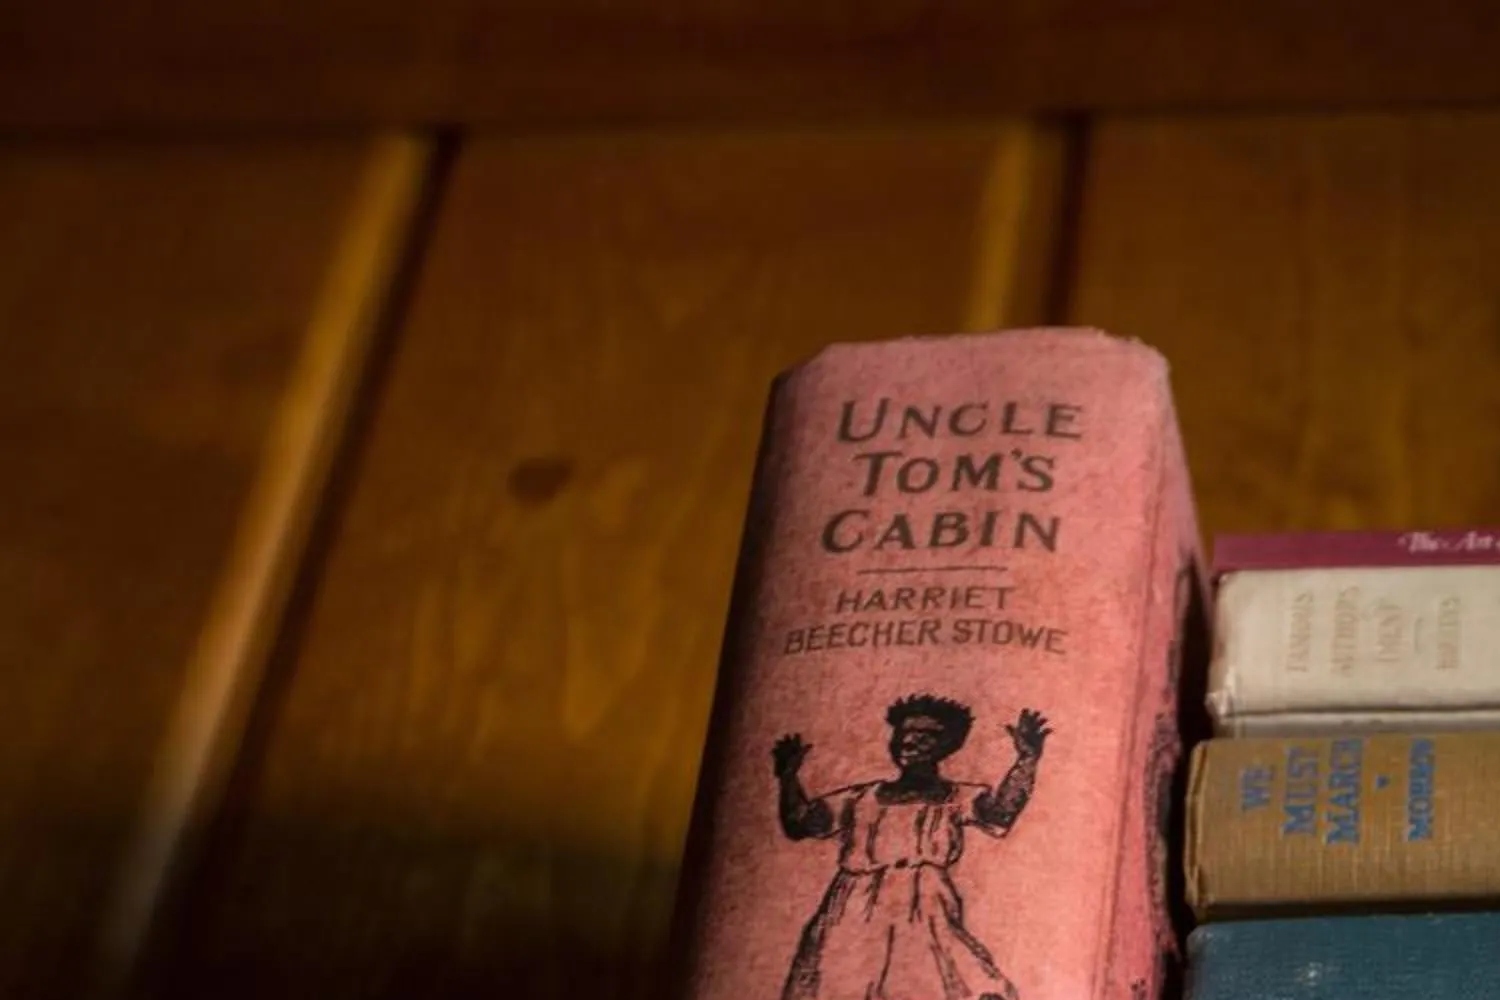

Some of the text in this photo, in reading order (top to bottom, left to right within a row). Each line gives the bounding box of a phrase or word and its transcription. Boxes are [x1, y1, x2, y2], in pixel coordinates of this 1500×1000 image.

[837, 398, 1082, 443] UNCLE
[853, 449, 1055, 496] TOM'S
[821, 509, 1061, 553] CABIN
[836, 586, 1016, 614] HARRIET
[783, 618, 1069, 656] BEECHER STOWE
[1241, 764, 1276, 812] WE
[1282, 746, 1318, 837] MUST
